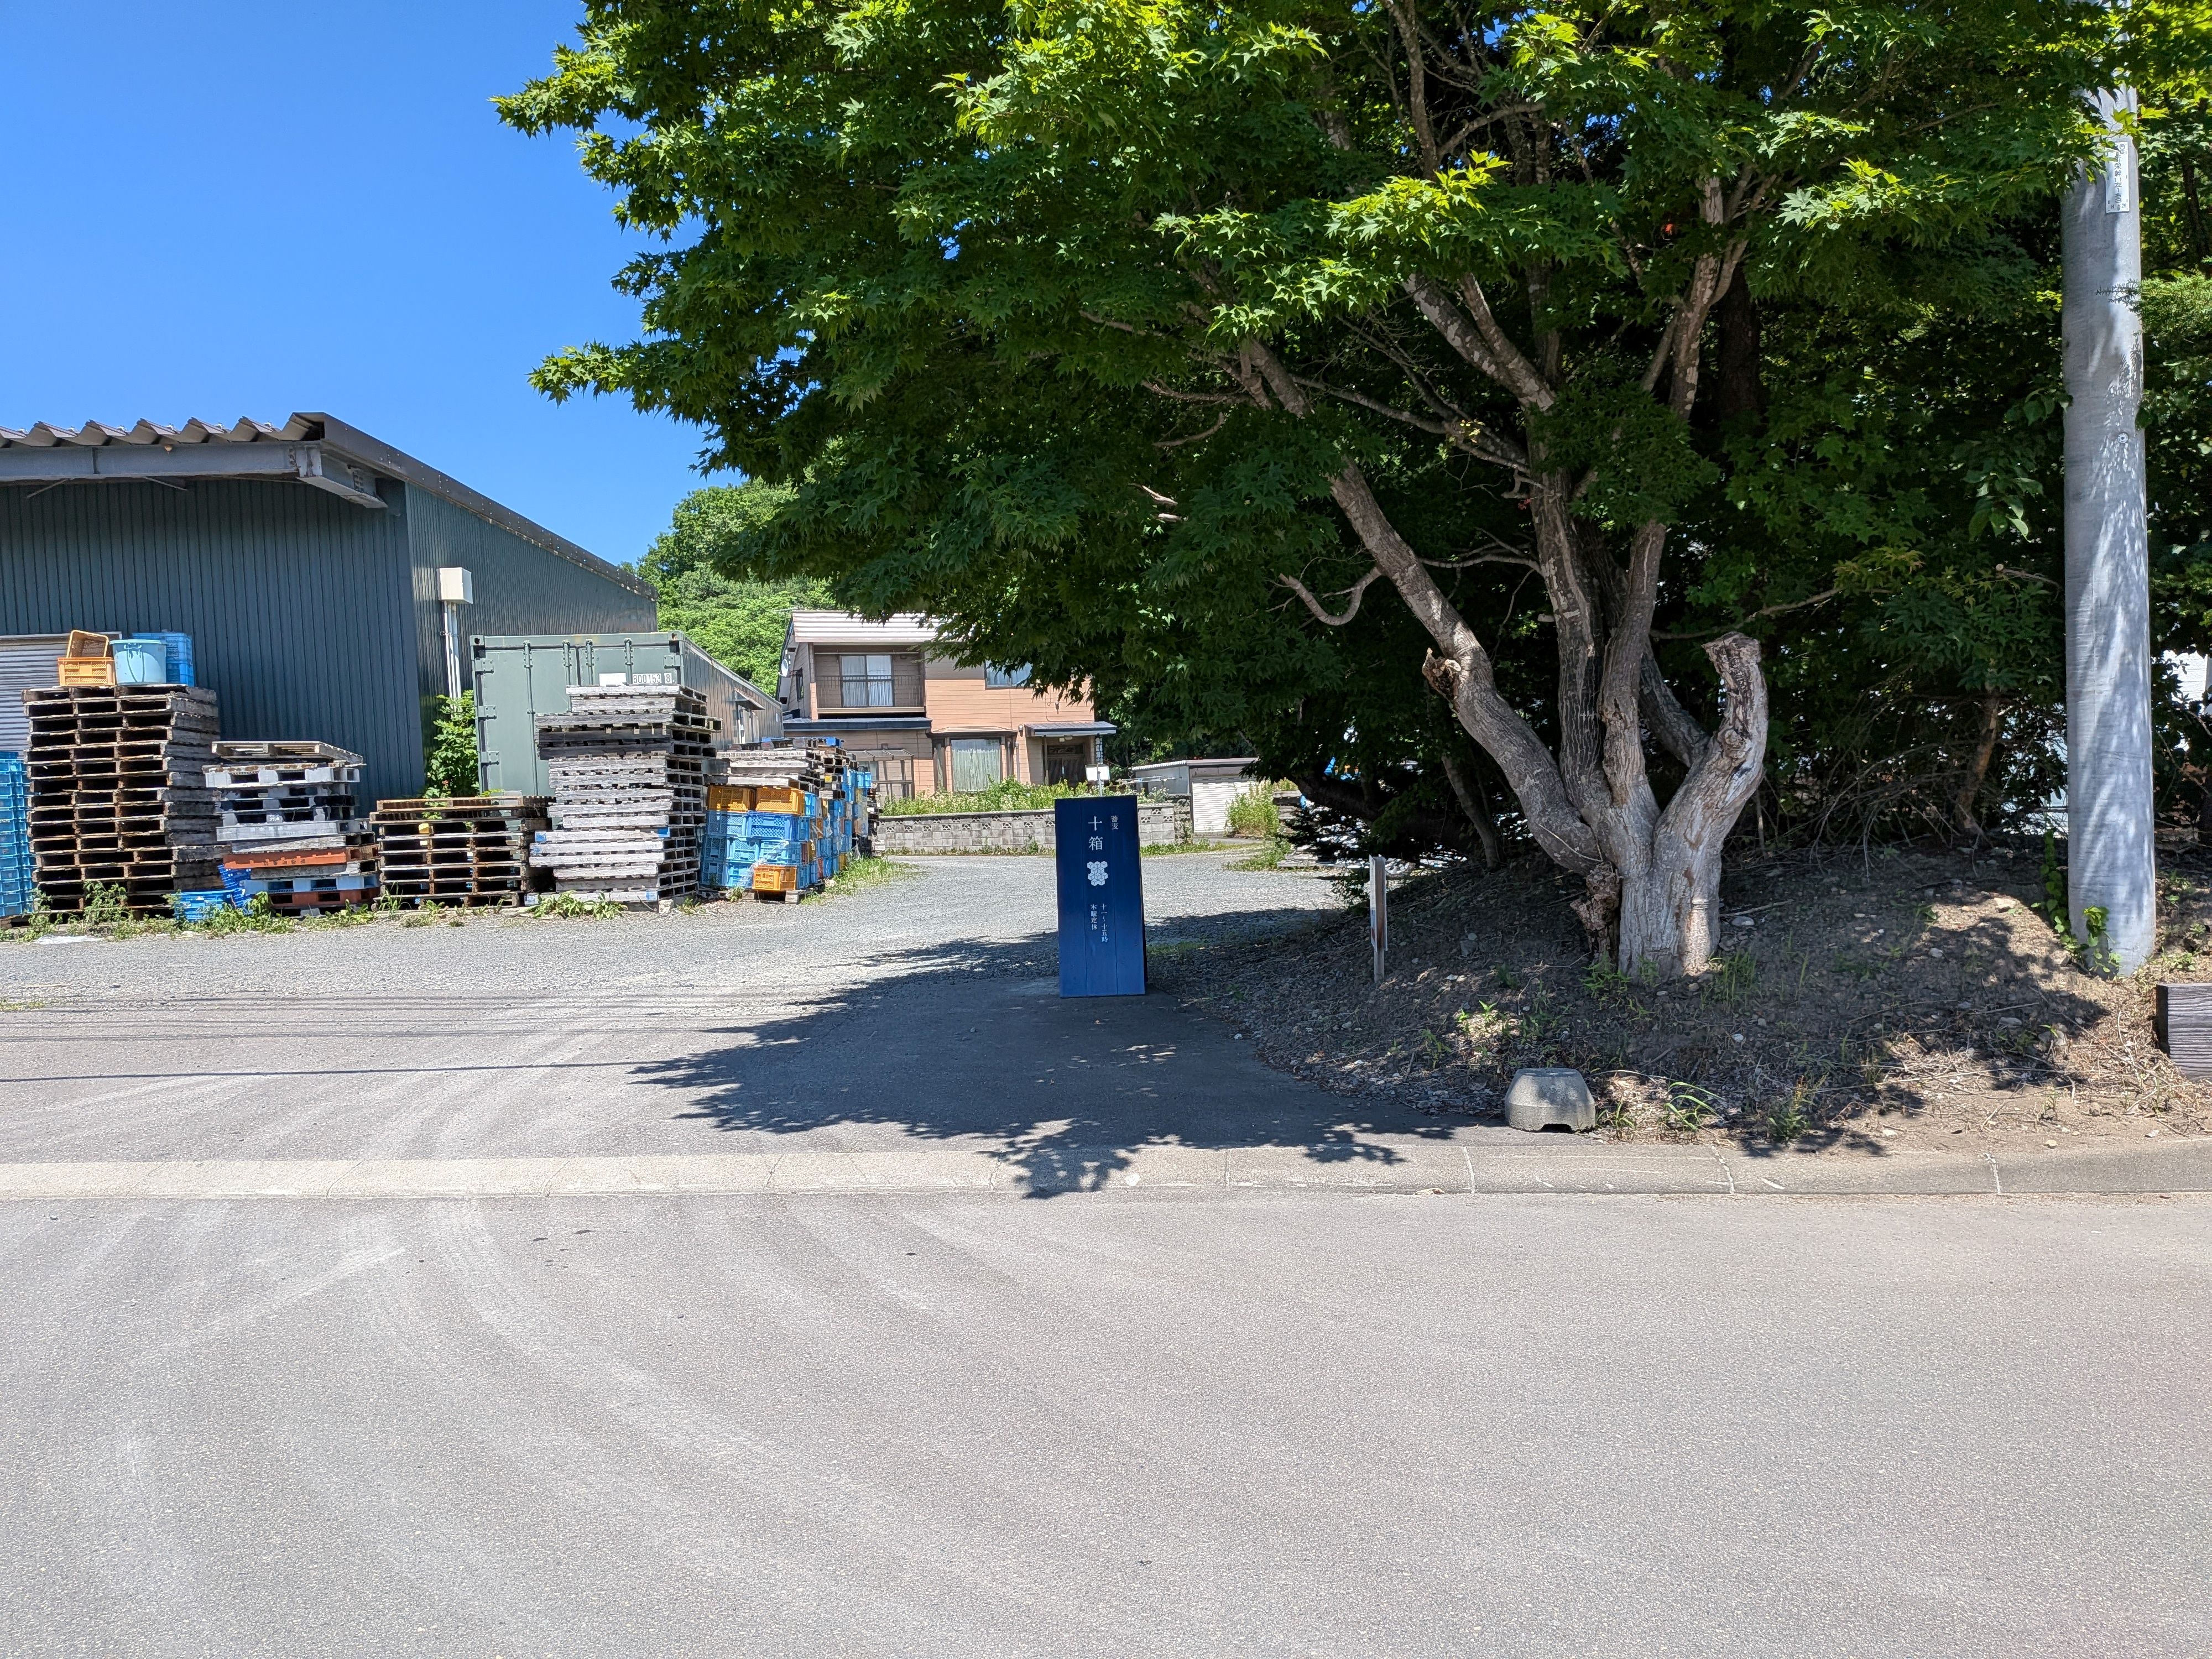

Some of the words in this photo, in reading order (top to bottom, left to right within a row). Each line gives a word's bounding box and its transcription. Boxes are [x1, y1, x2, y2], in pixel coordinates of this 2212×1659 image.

[633, 674, 661, 684] 800153
[666, 674, 670, 683] 8
[1088, 816, 1103, 851] 十箱
